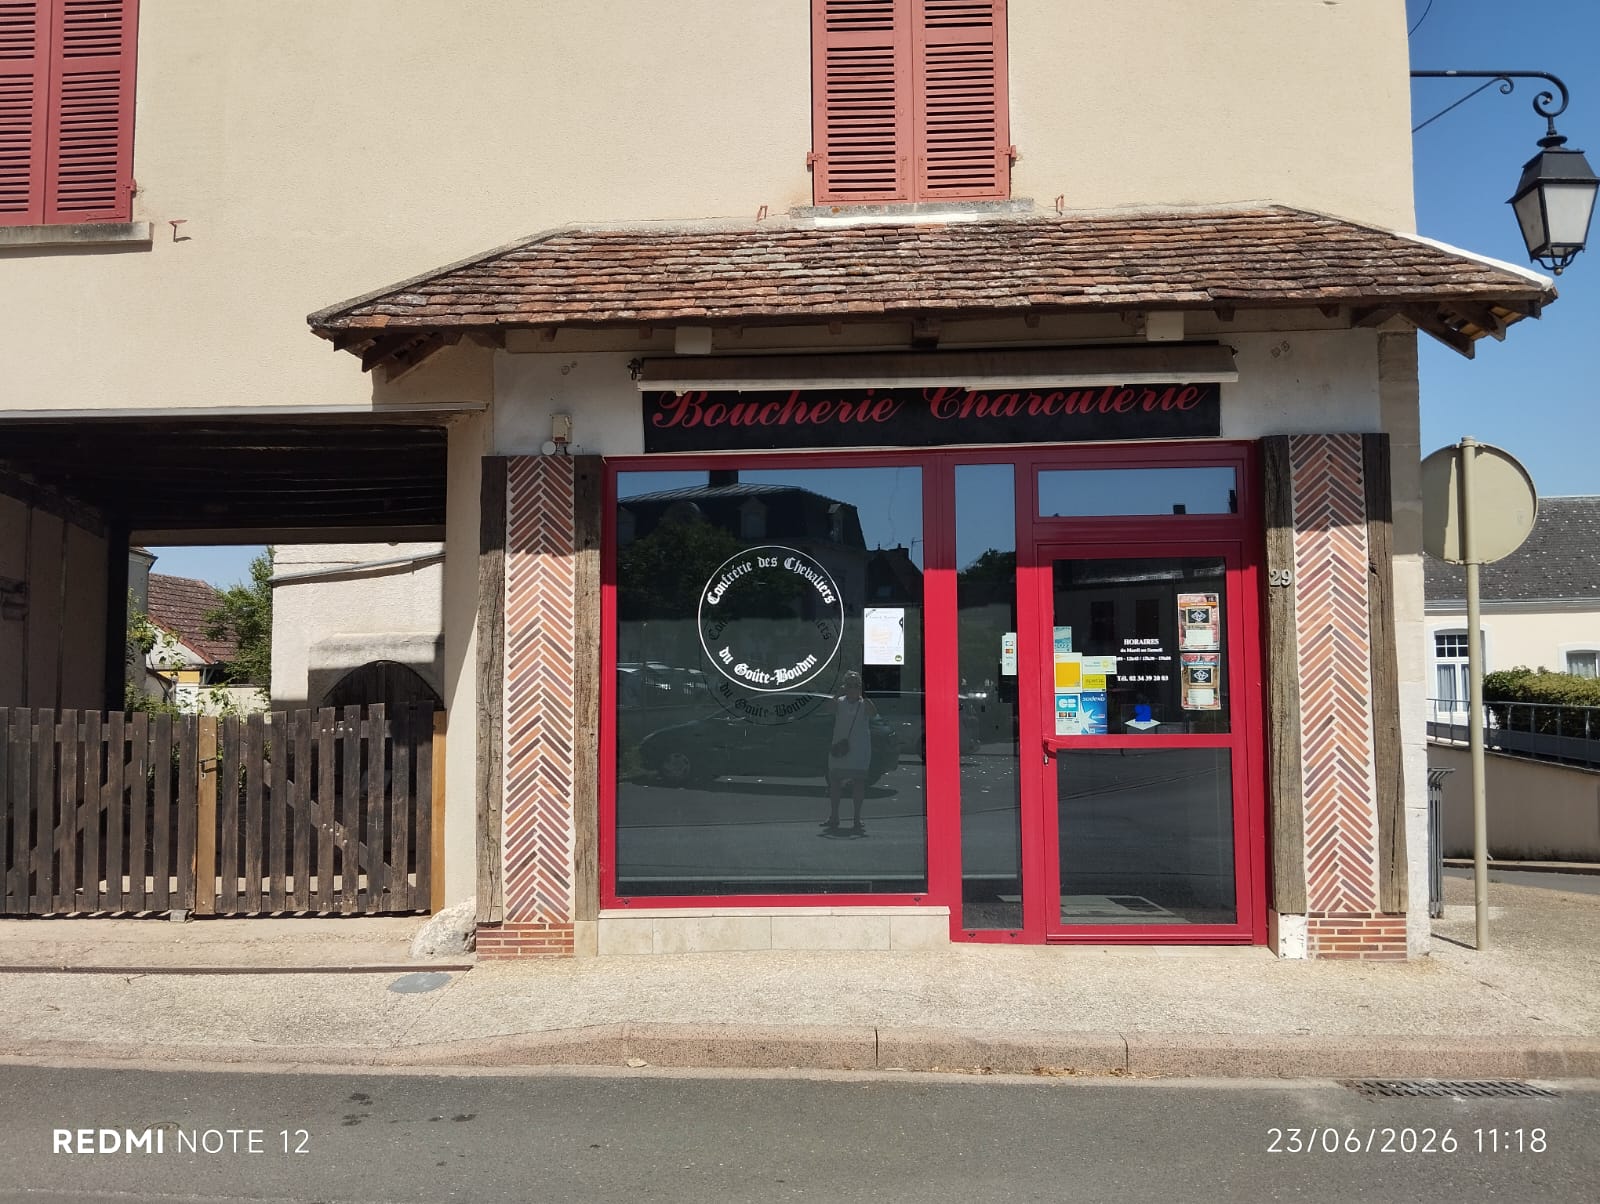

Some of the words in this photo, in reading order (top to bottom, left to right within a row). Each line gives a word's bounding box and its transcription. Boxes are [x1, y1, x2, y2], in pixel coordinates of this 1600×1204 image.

[652, 389, 905, 428] Boucherie
[923, 386, 1206, 419] Charcuterie
[706, 560, 752, 605] Confrérie
[757, 556, 778, 568] des
[783, 557, 837, 605] Chevaliers
[1269, 569, 1292, 588] 29
[1123, 638, 1160, 646] HORAIRES
[718, 646, 734, 665] du
[734, 654, 818, 686] Goûte-Boudin
[1058, 698, 1077, 708] CB
